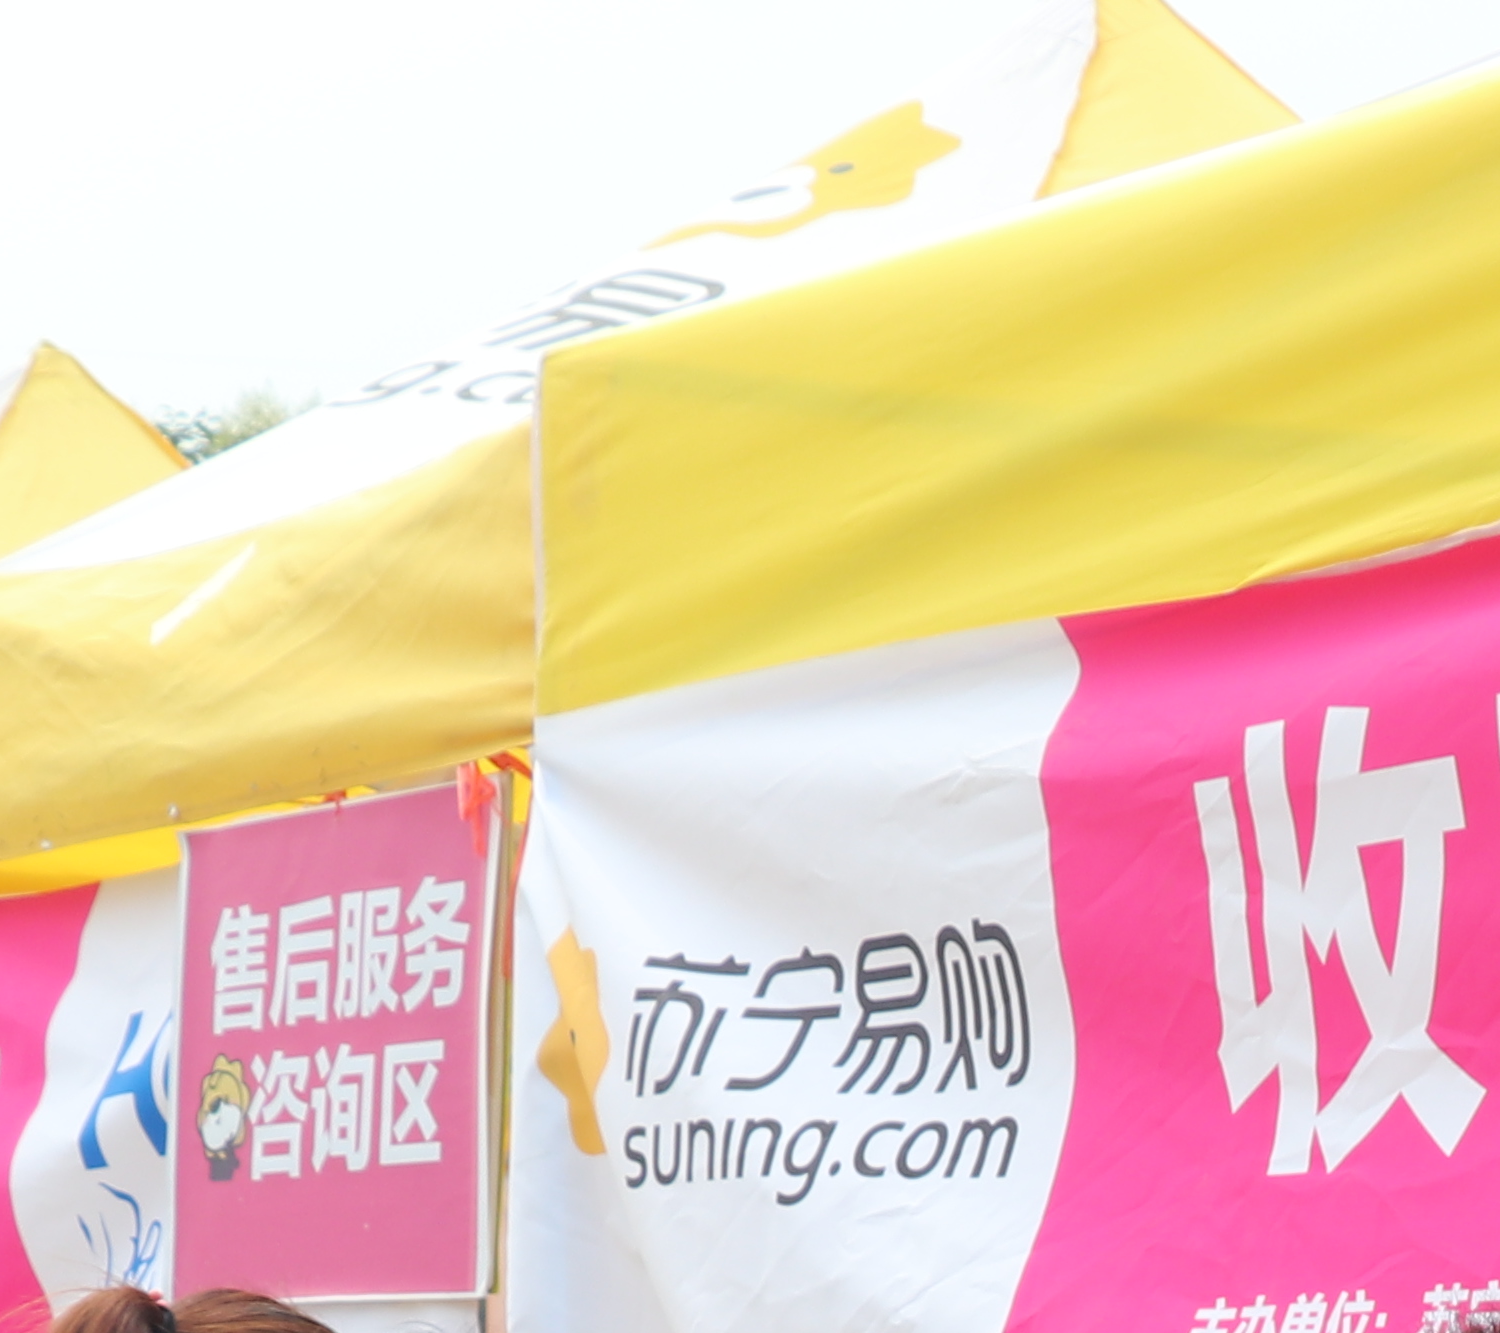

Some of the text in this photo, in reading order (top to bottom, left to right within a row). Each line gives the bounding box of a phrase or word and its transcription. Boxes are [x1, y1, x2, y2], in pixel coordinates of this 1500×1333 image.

[210, 875, 470, 1036] 售后服务
[624, 918, 1032, 1098] 苏宁易购
[247, 1038, 445, 1181] 咨询区
[623, 1115, 1020, 1207] suning.com
